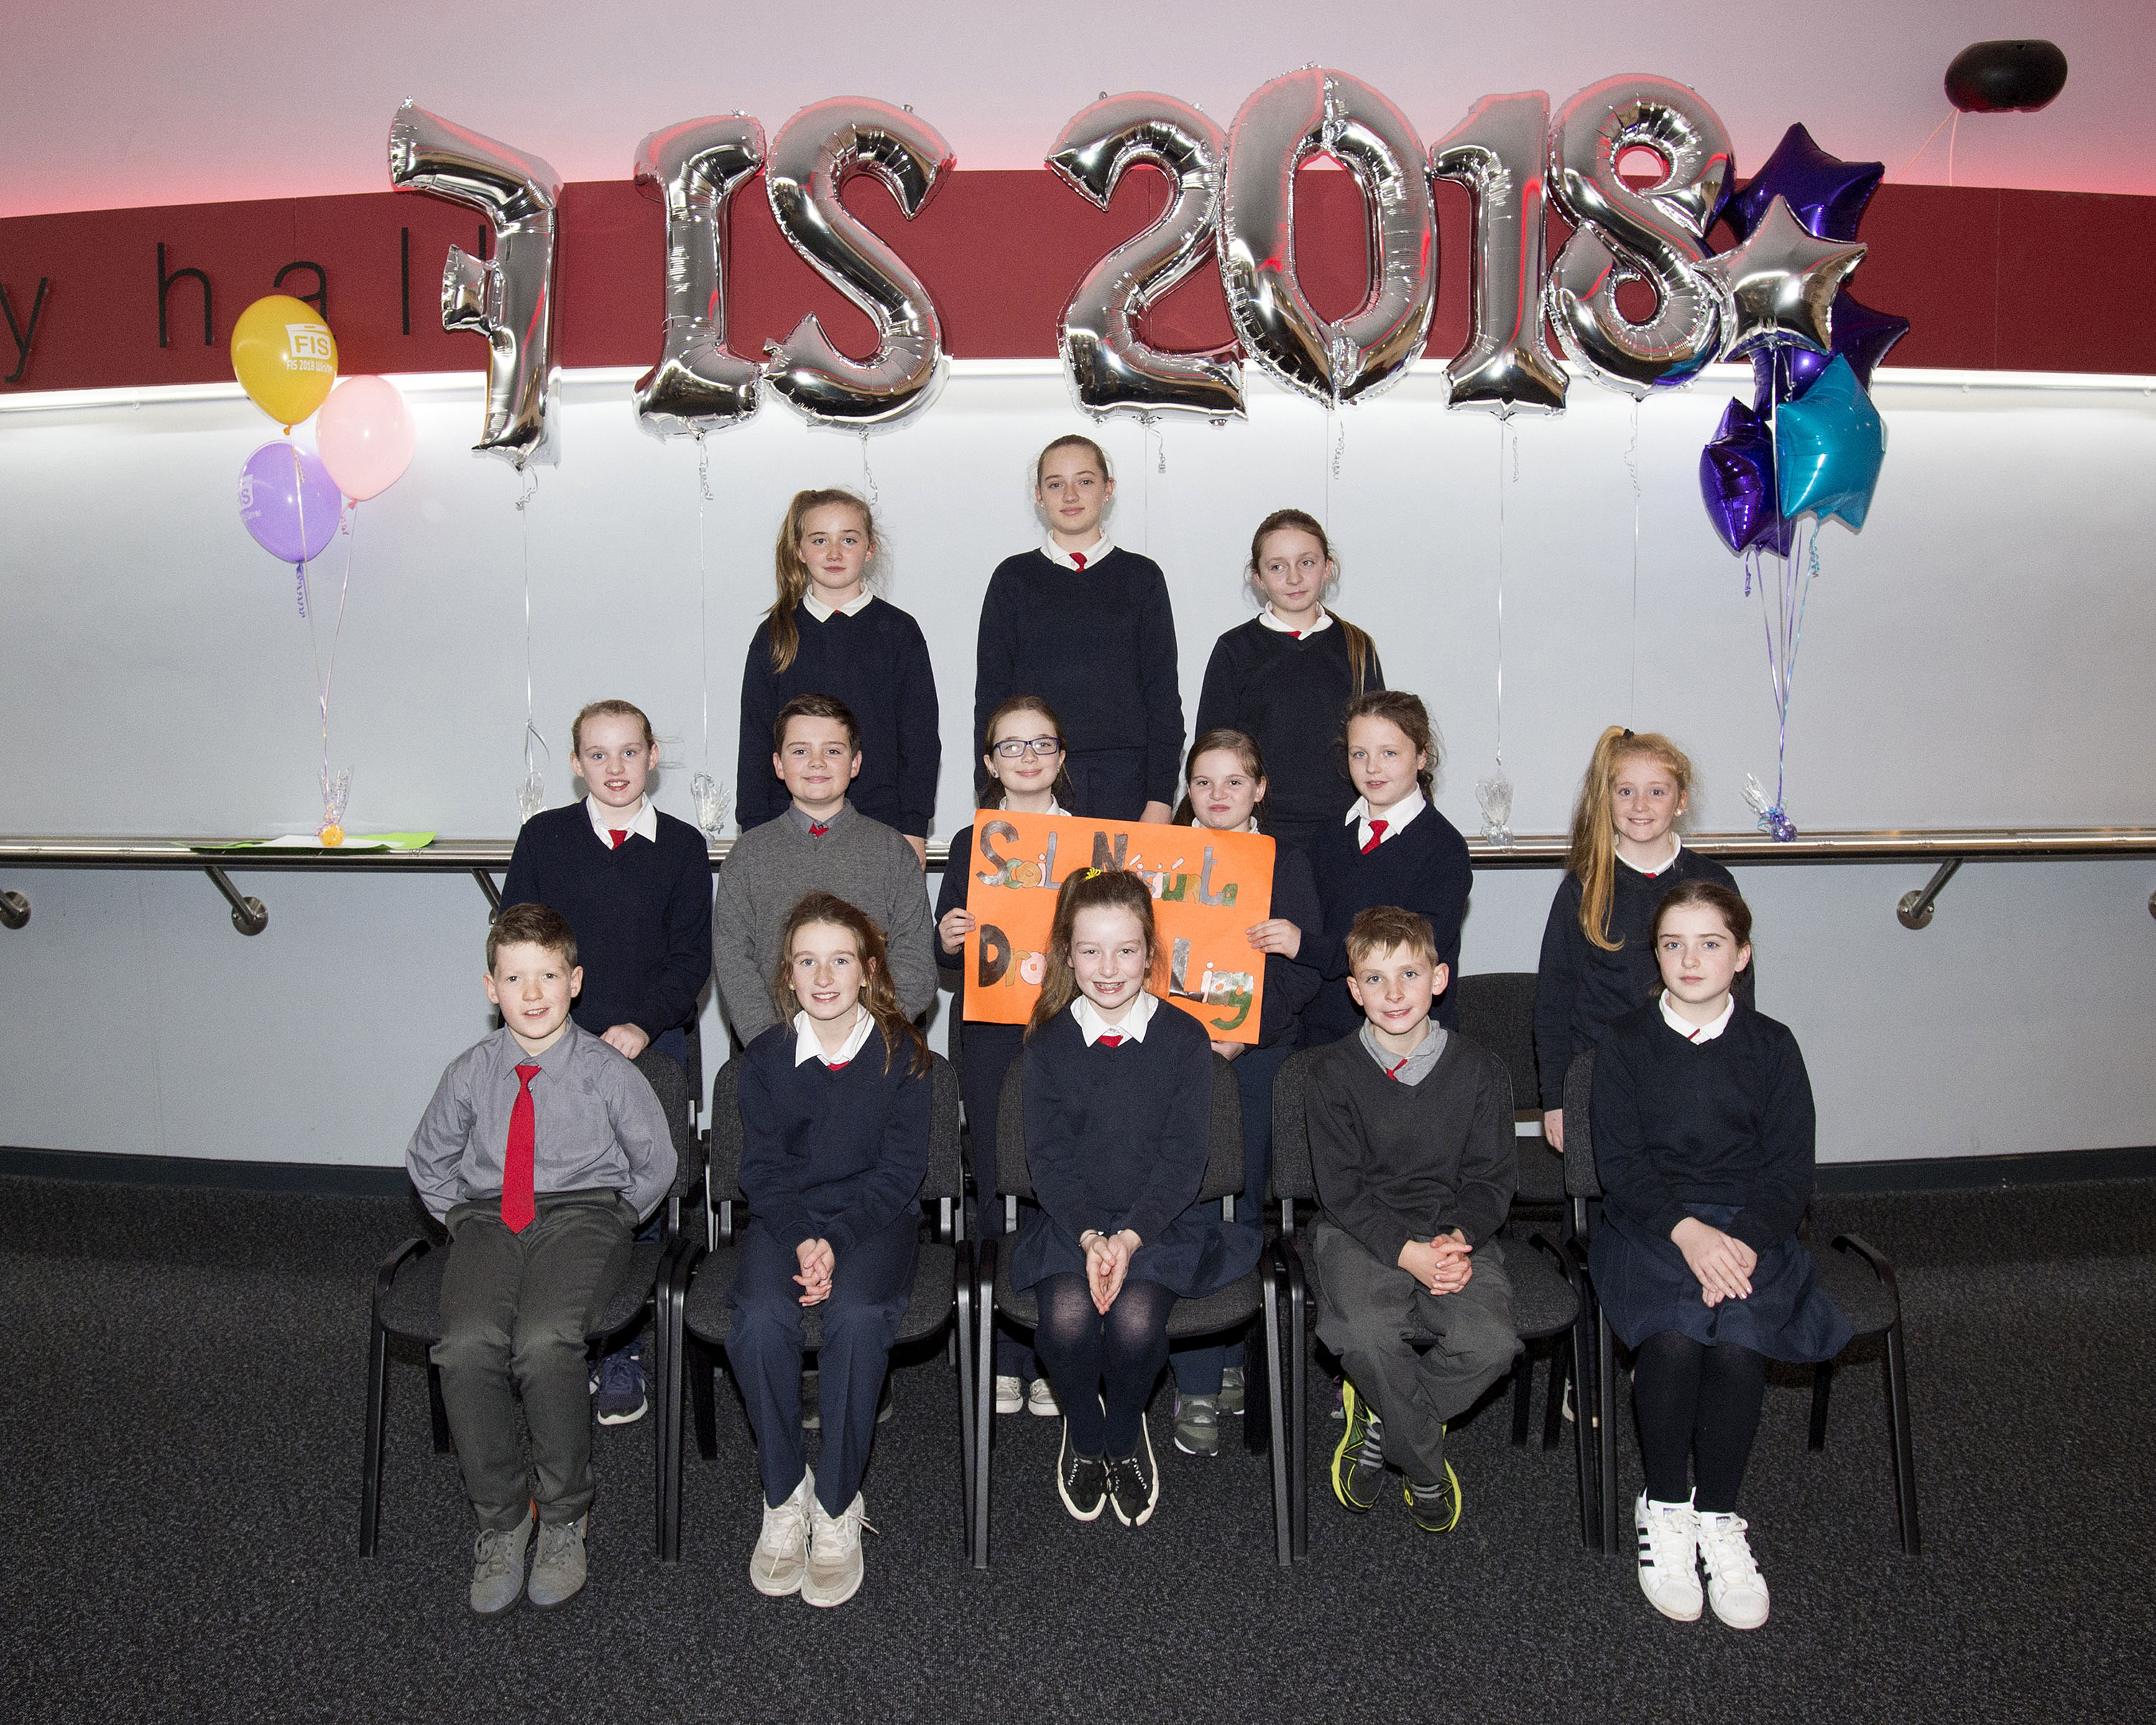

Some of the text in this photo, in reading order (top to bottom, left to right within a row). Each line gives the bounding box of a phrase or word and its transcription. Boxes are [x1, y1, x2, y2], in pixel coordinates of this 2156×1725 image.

[1044, 63, 1736, 424] 2018
[294, 335, 329, 356] FIS
[287, 359, 298, 371] FIS
[299, 359, 315, 371] 2018
